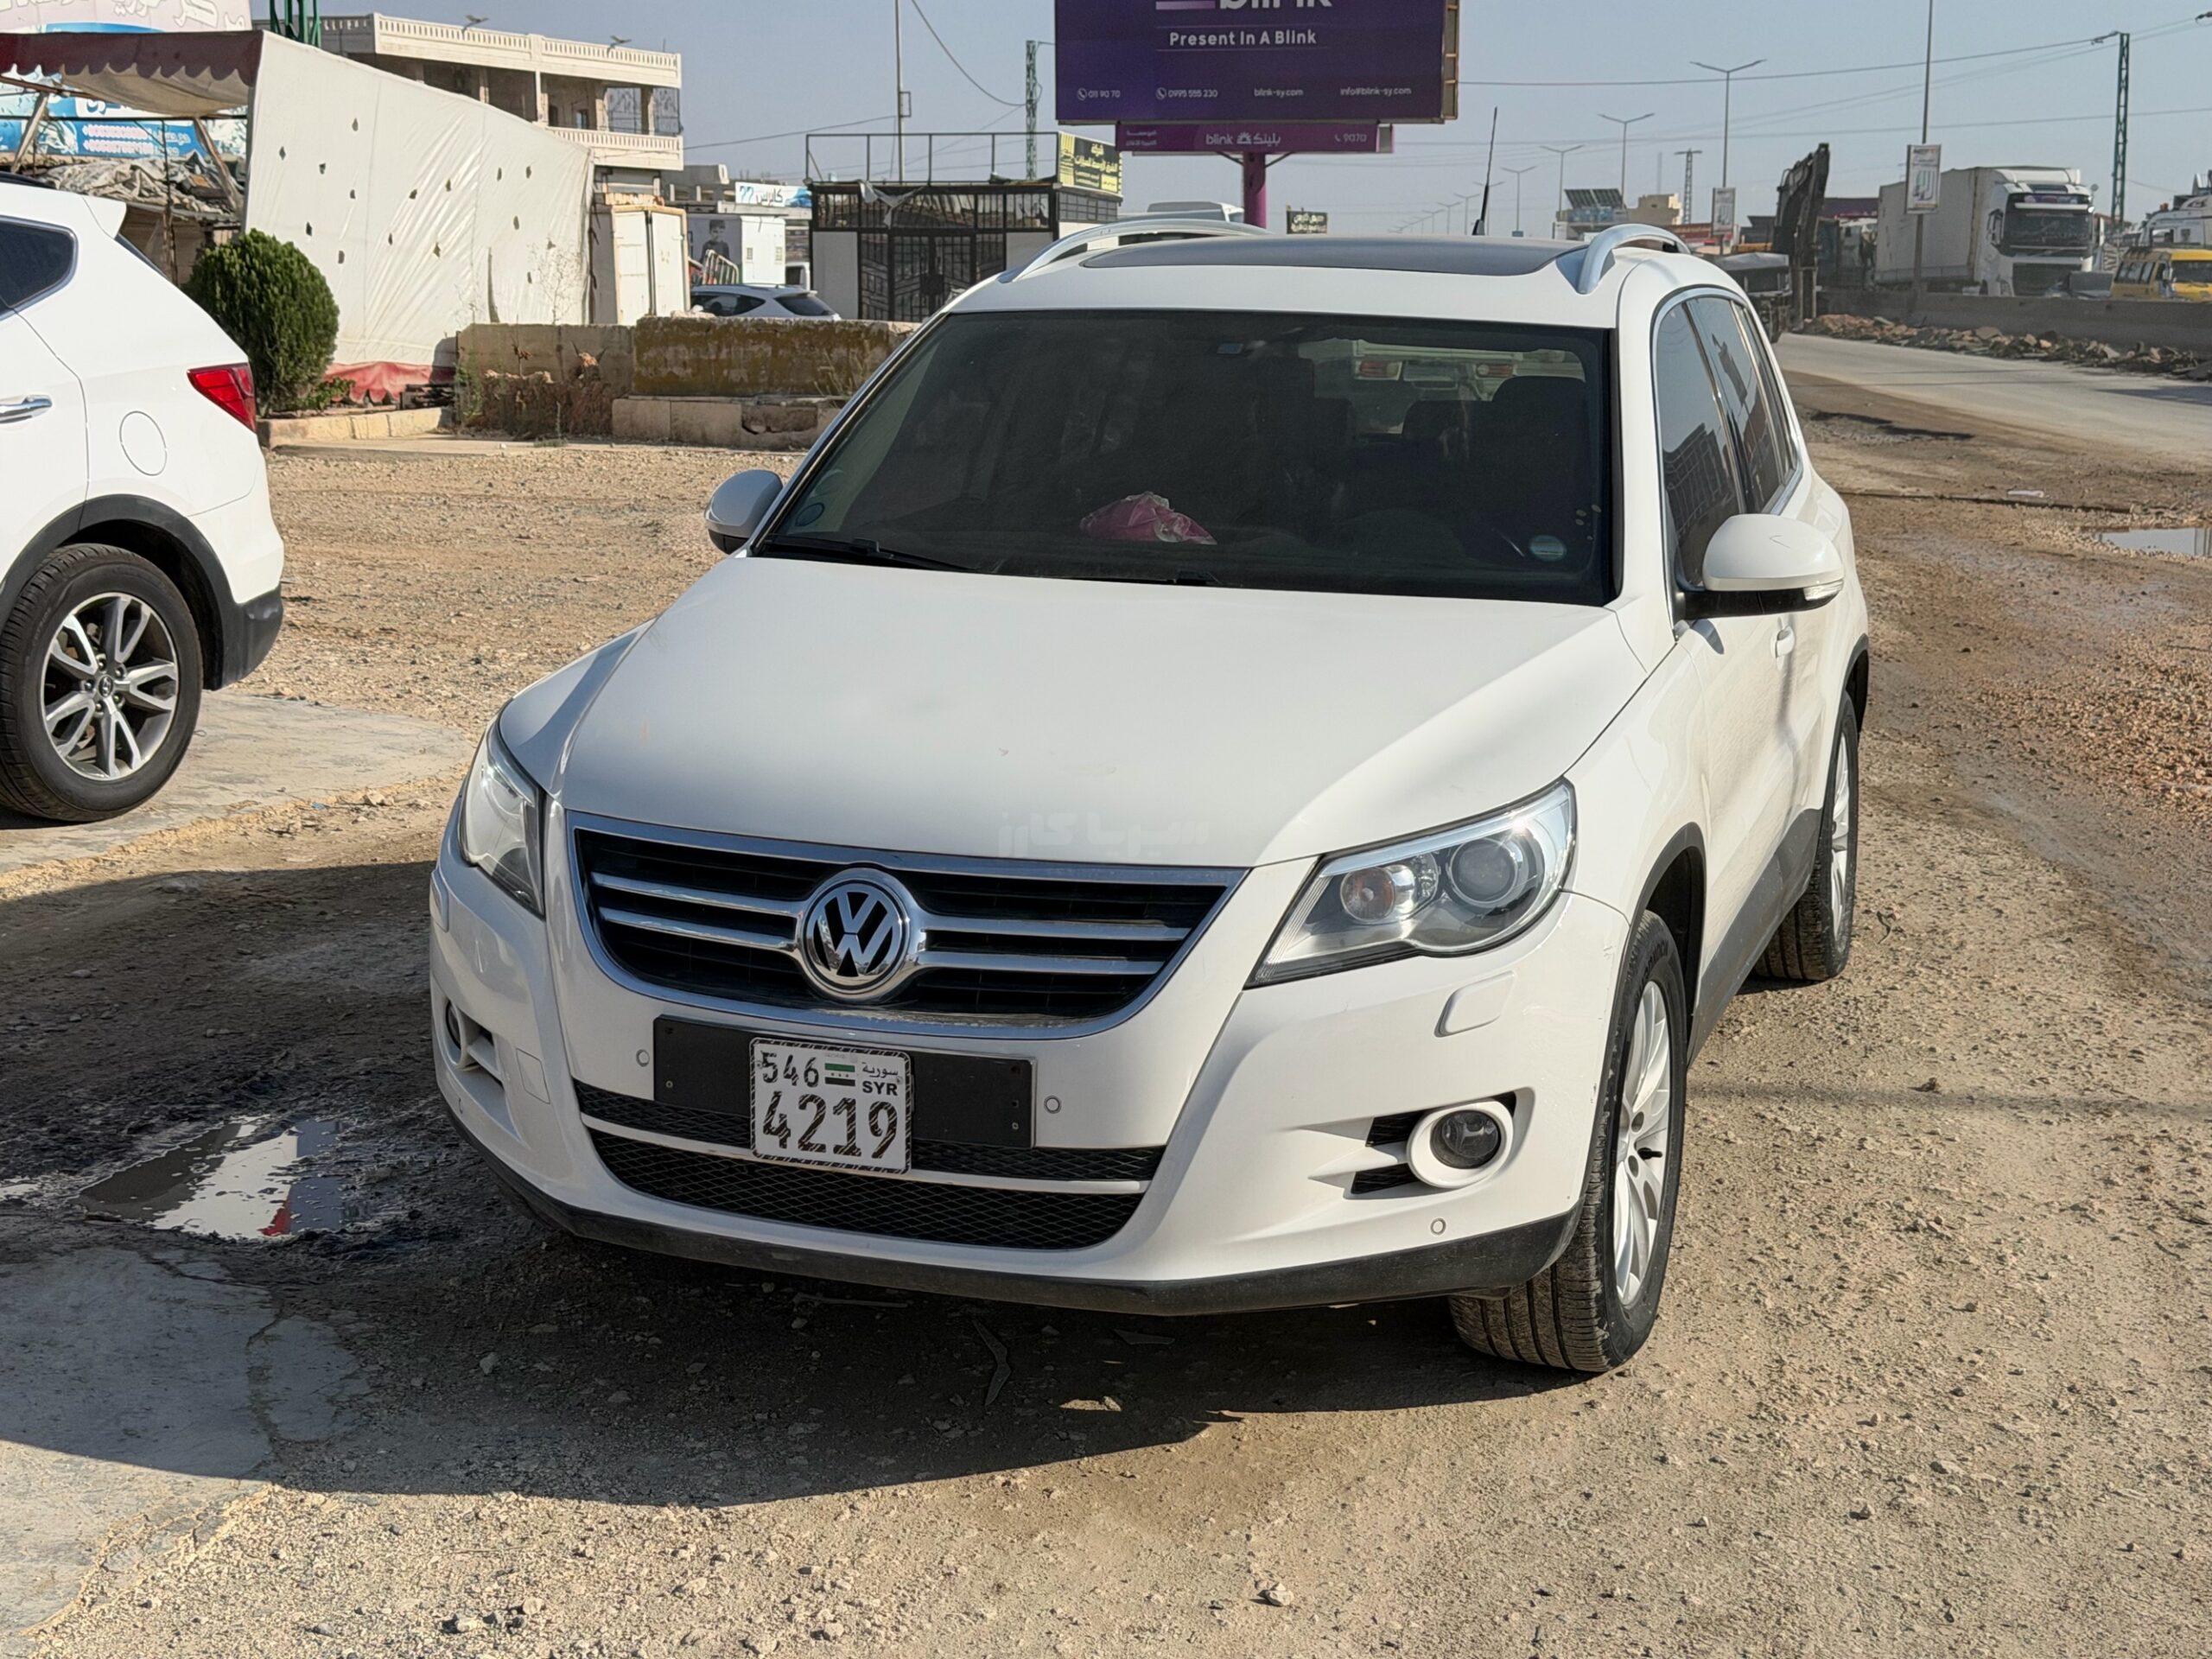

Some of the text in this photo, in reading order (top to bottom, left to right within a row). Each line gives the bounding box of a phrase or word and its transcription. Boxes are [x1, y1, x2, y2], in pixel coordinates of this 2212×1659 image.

[1169, 29, 1317, 46] Present In A Blink
[1205, 133, 1233, 145] blink
[760, 1050, 819, 1088] 546
[861, 1061, 899, 1078] سورية
[862, 1080, 899, 1096] SYR
[762, 1090, 899, 1160] 4219
